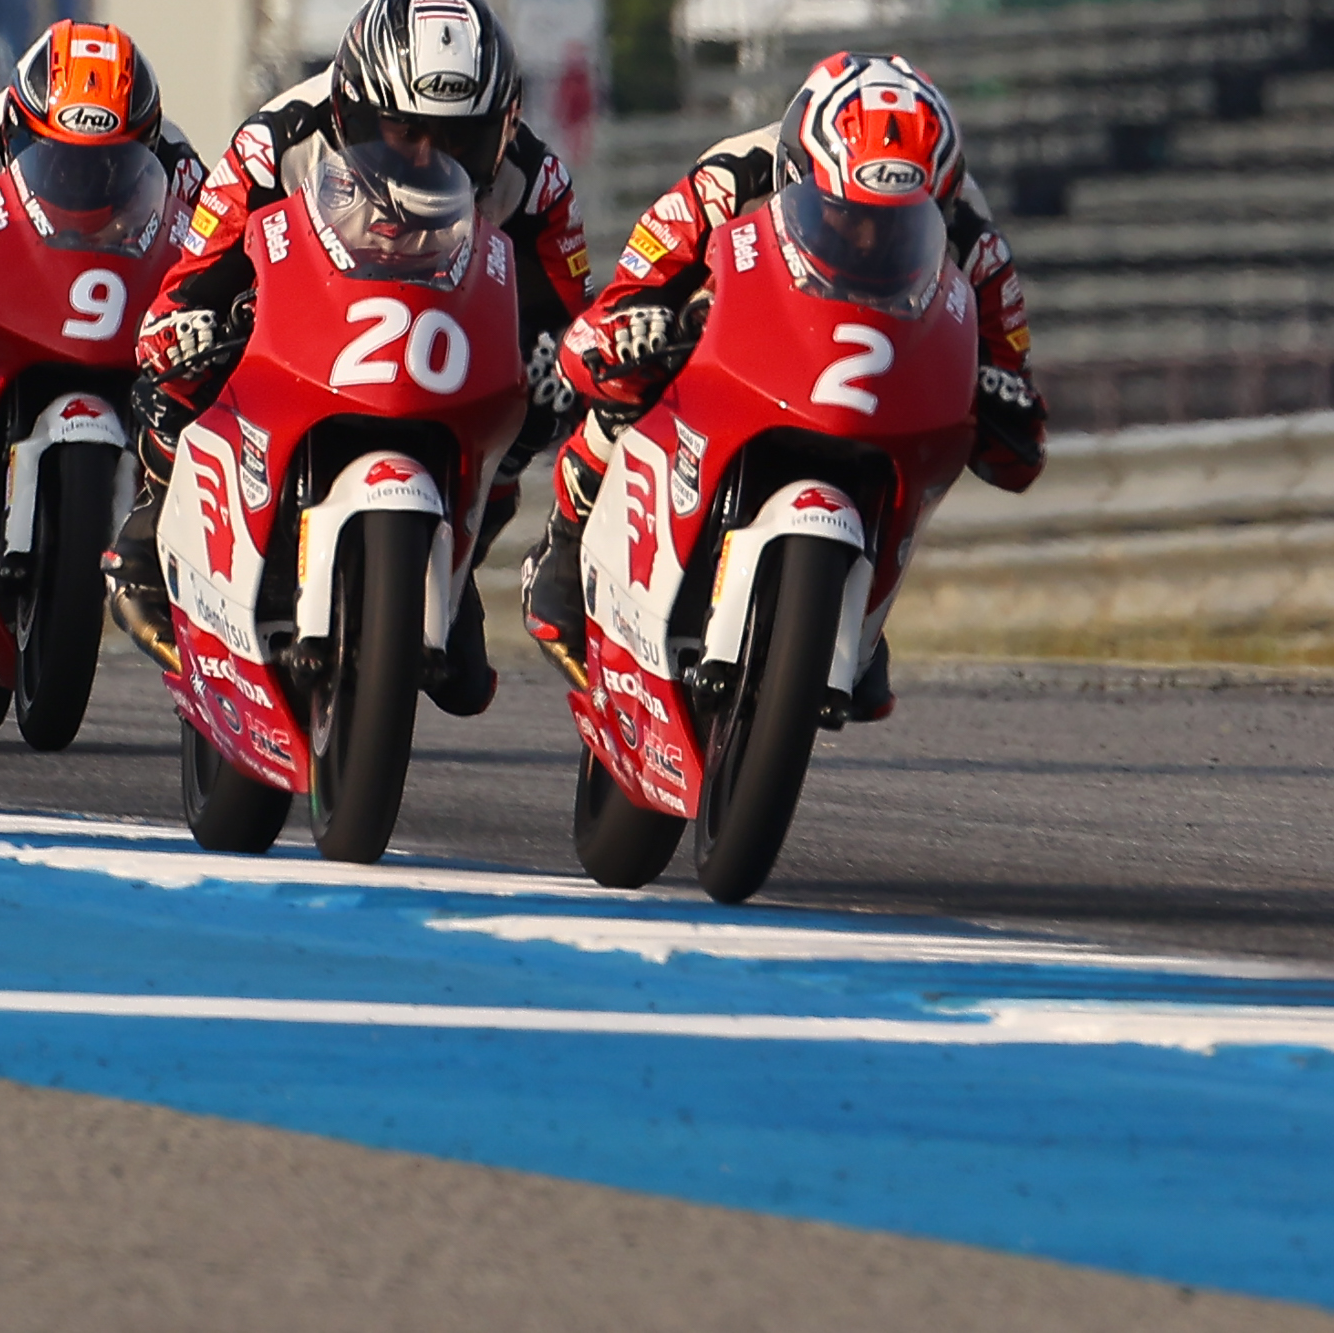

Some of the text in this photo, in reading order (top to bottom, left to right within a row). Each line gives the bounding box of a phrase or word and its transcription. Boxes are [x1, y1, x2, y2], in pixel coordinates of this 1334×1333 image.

[418, 75, 473, 93] Arai
[60, 106, 112, 127] Arai
[862, 163, 917, 184] Arai
[265, 221, 290, 264] Beta
[319, 226, 356, 271] WRS
[733, 229, 759, 272] Beta
[62, 269, 127, 341] 9
[330, 297, 469, 394] 20
[810, 322, 895, 416] 2
[366, 486, 438, 507] idemitsu
